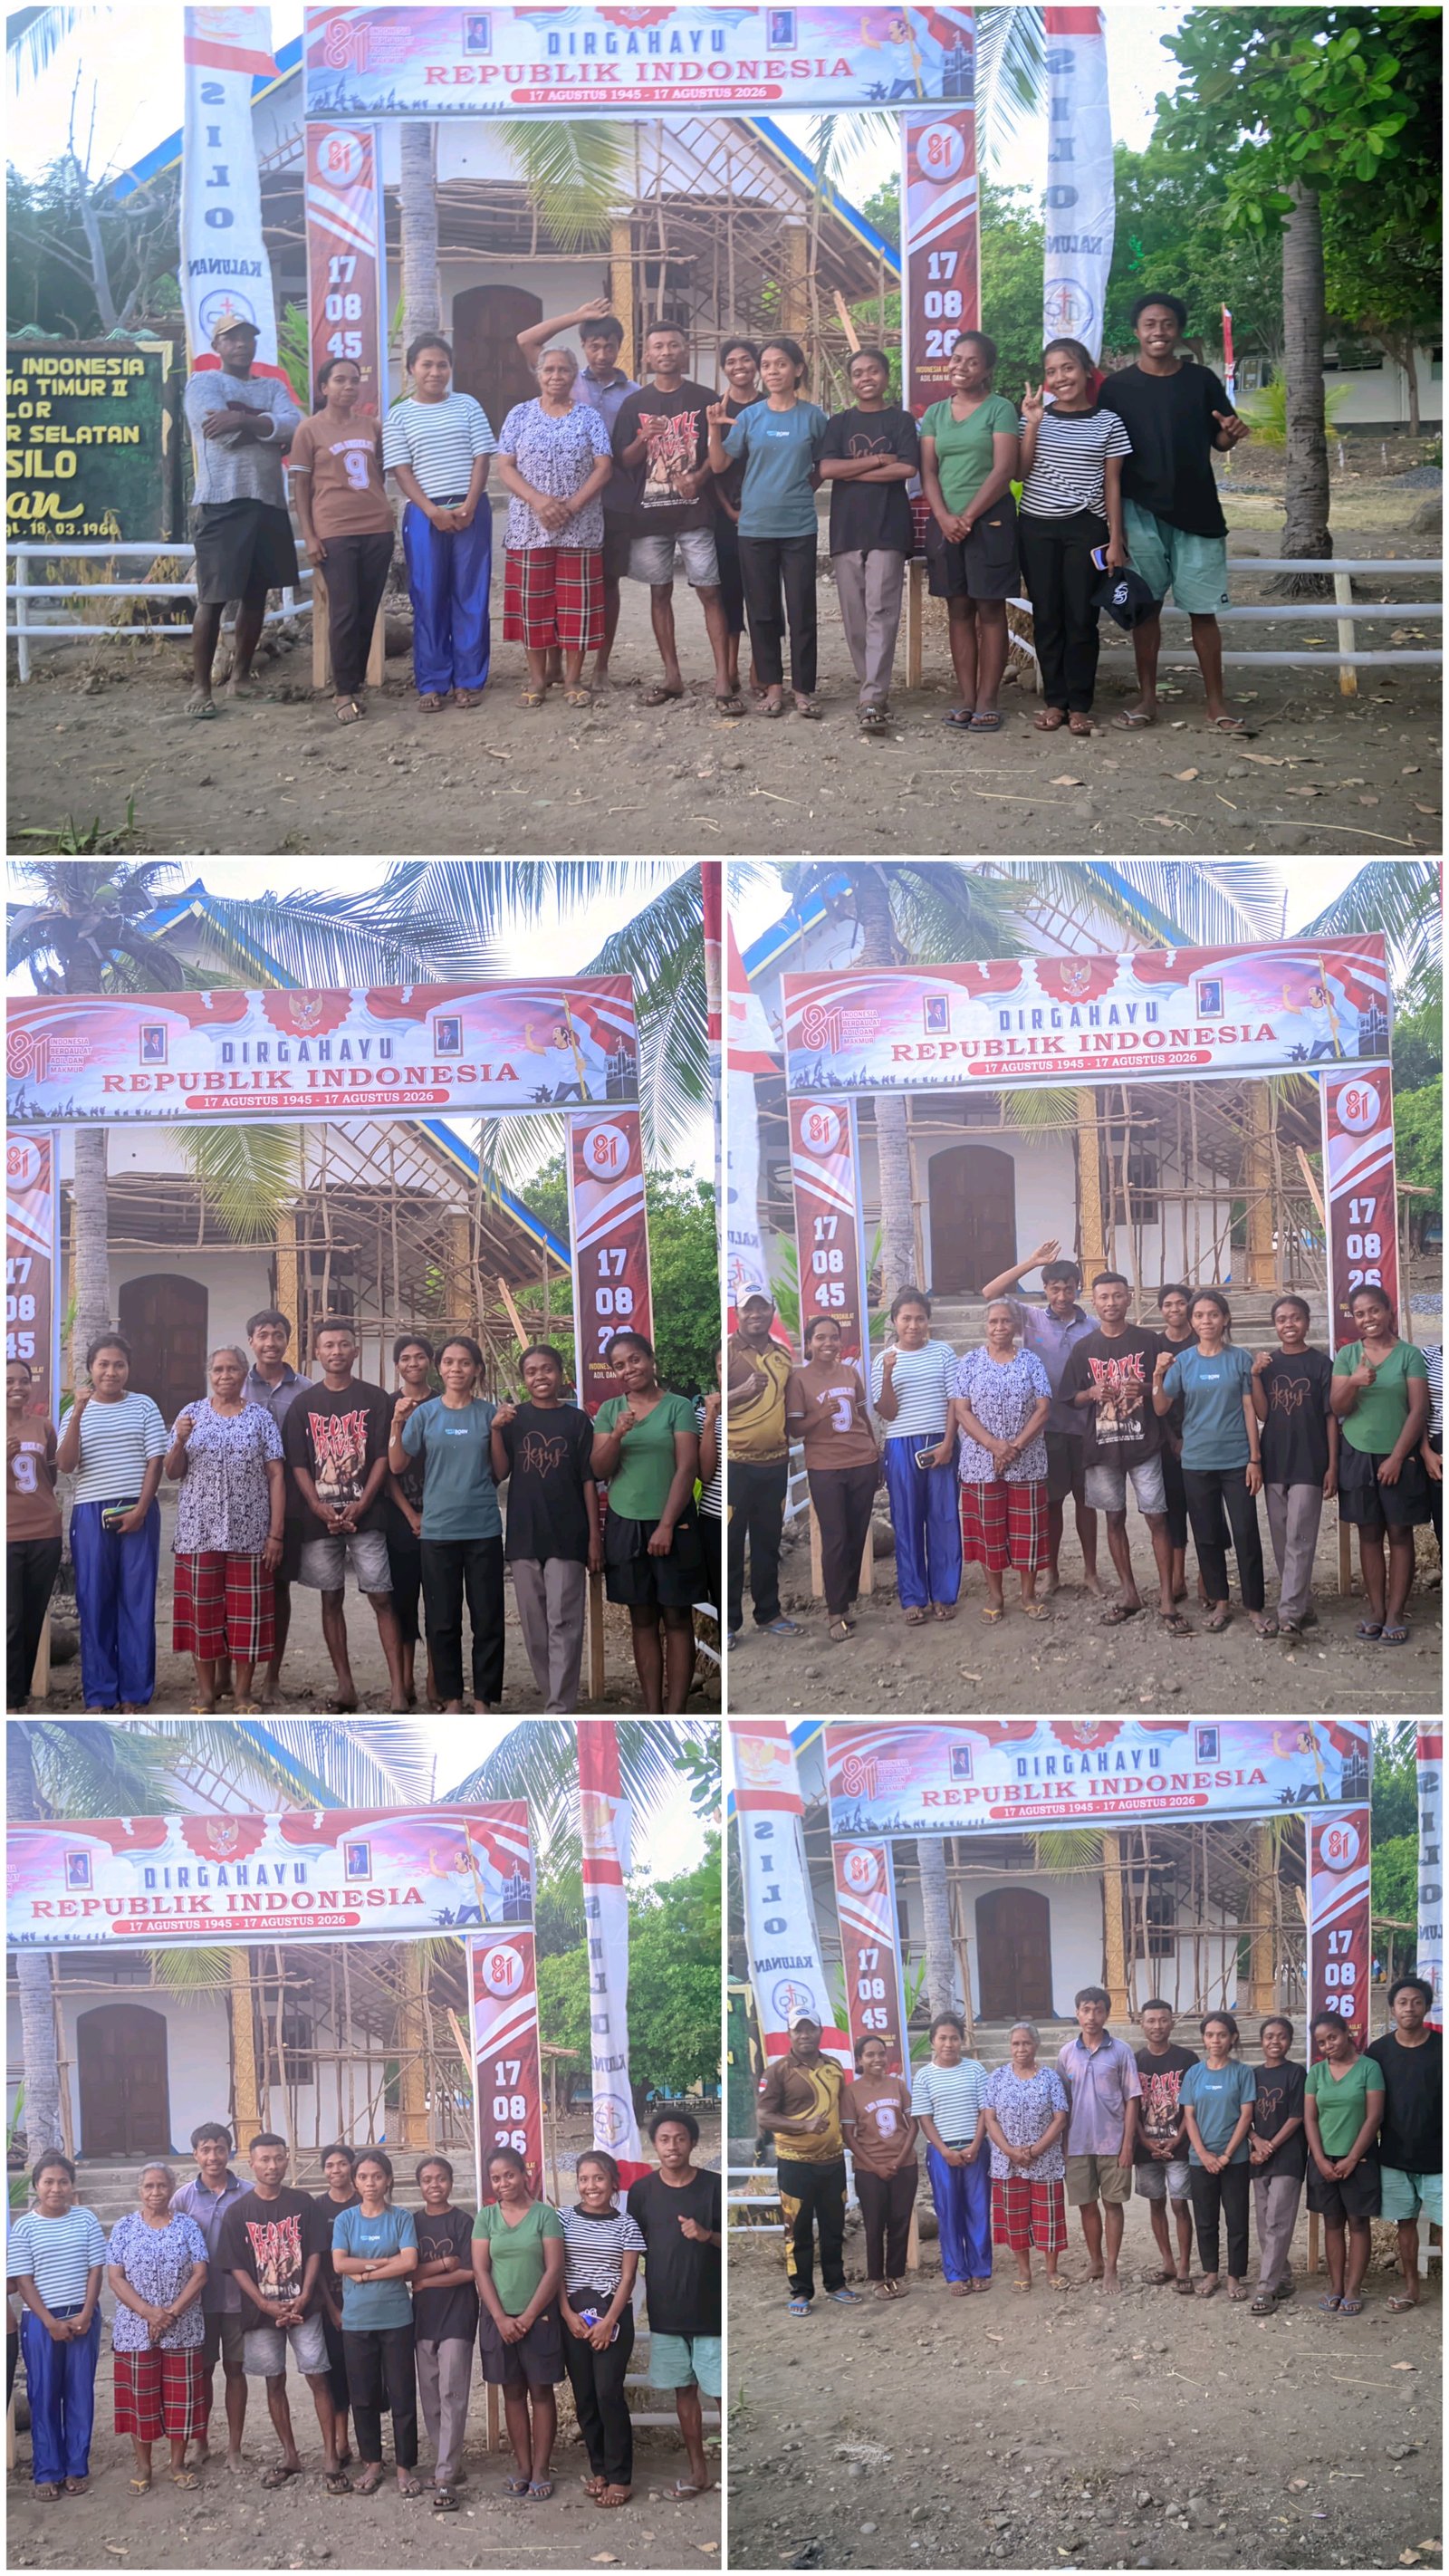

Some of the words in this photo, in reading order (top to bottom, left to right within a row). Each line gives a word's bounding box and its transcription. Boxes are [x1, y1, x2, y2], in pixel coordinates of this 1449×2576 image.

[547, 29, 725, 55] DIRGAHAYU
[423, 62, 621, 85] REPUBLIK
[636, 57, 854, 82] INDONESIA
[529, 91, 543, 101] 17
[547, 90, 607, 101] AGUSTUS
[610, 89, 641, 101] 1945
[654, 89, 668, 100] 17
[671, 88, 732, 100] AGUSTUS
[734, 87, 767, 98] 2026
[328, 255, 357, 284] 17
[927, 251, 958, 280] 17
[325, 293, 362, 322] 08
[924, 290, 963, 319] 08
[326, 331, 363, 359] 45
[22, 358, 145, 376] INDONESIA
[36, 379, 106, 397] TIMUR
[29, 425, 139, 444] SELATAN
[6, 449, 77, 479] SILO
[344, 450, 369, 490] 9
[999, 1001, 1159, 1031] DIRGAHAYU
[221, 1037, 394, 1064] DIRGAHAYU
[891, 1035, 1065, 1062] REPUBLIK
[1079, 1023, 1277, 1053] INDONESIA
[984, 1063, 998, 1073] 17
[1001, 1061, 1052, 1072] AGUSTUS
[1056, 1059, 1085, 1070] 1945
[1095, 1057, 1109, 1068] 17
[1111, 1054, 1166, 1066] AGUSTUS
[1168, 1053, 1197, 1063] 2026
[101, 1070, 292, 1093] REPUBLIK
[306, 1062, 521, 1089] INDONESIA
[203, 1097, 219, 1108] 17
[223, 1095, 278, 1107] AGUSTUS
[283, 1094, 312, 1105] 1945
[324, 1093, 340, 1104] 17
[342, 1091, 401, 1103] AGUSTUS
[404, 1091, 434, 1101] 2026
[1346, 1089, 1370, 1121] 81
[809, 1114, 830, 1145] 81
[592, 1133, 618, 1168] 81
[1348, 1197, 1377, 1224] 17
[813, 1216, 838, 1240] 17
[1347, 1233, 1381, 1260] 08
[598, 1248, 627, 1276] 17
[811, 1249, 843, 1274] 08
[595, 1286, 633, 1314] 08
[814, 1283, 845, 1307] 45
[308, 1408, 370, 1447] PEOPLE
[519, 1434, 569, 1474] Jesus
[11, 1454, 38, 1494] 9
[1017, 1748, 1160, 1777] DIRGAHAYU
[922, 1781, 1077, 1807] REPUBLIK
[1090, 1767, 1268, 1795] INDONESIA
[1003, 1808, 1015, 1816] 17
[1019, 1805, 1066, 1815] AGUSTUS
[1069, 1802, 1093, 1812] 1945
[1103, 1801, 1117, 1811] 17
[1118, 1798, 1167, 1809] AGUSTUS
[1169, 1796, 1195, 1806] 2026
[144, 1863, 308, 1889] DIRGAHAYU
[31, 1895, 213, 1918] REPUBLIK
[226, 1887, 425, 1912] INDONESIA
[130, 1923, 141, 1932] 17
[147, 1920, 200, 1930] AGUSTUS
[204, 1919, 232, 1929] 1945
[244, 1918, 257, 1927] 17
[261, 1917, 314, 1927] AGUSTUS
[318, 1916, 346, 1925] 2026
[1328, 1929, 1353, 1955] 17
[857, 1947, 878, 1971] 17
[1324, 1962, 1356, 1986] 08
[858, 1978, 885, 2001] 08
[861, 2006, 888, 2030] 45
[494, 2060, 521, 2086] 17
[492, 2095, 526, 2121] 08
[876, 2108, 897, 2139] 9
[245, 2224, 302, 2253] PEOPLE
